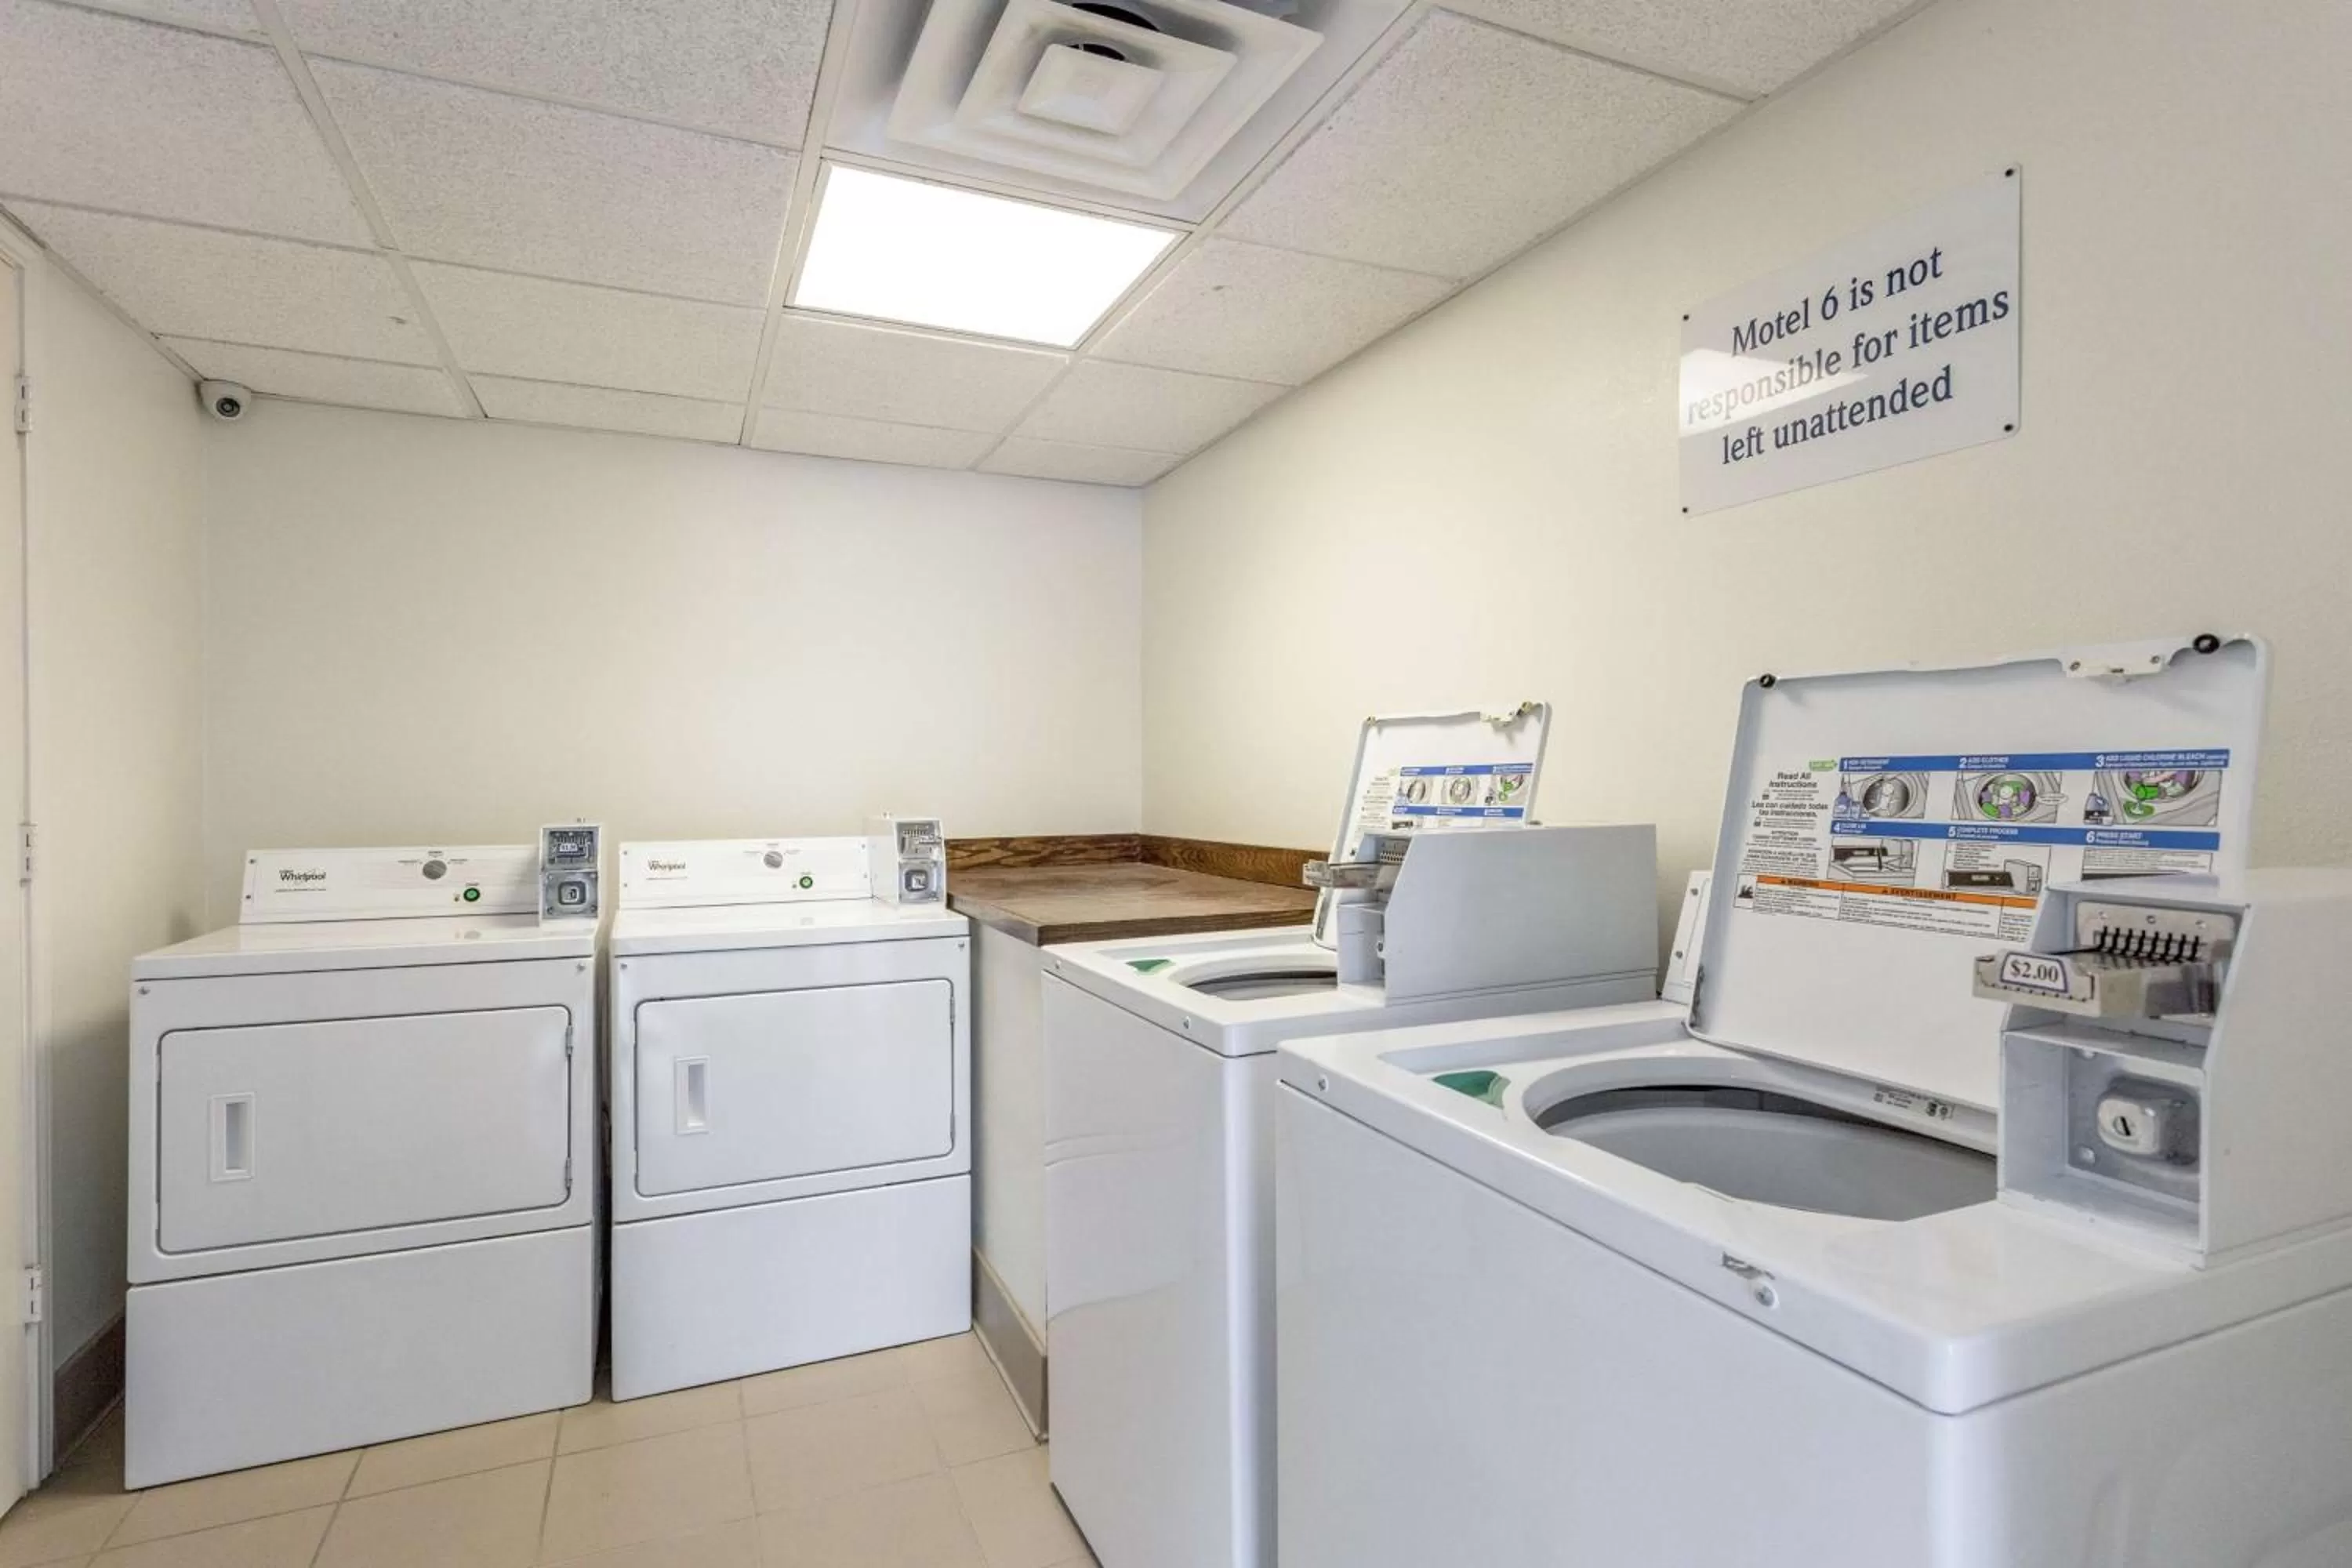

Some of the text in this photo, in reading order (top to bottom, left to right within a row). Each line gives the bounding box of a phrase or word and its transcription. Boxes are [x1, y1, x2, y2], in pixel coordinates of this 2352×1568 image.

[1730, 246, 1944, 358] Motel 6 is not
[1687, 290, 2010, 424] responsible for items
[1722, 365, 1954, 465] left unattended
[1959, 759, 1967, 768] 2
[2096, 755, 2105, 767] 3
[1833, 823, 1841, 832] 4
[1947, 826, 1957, 837] 5
[2085, 831, 2095, 843] 6
[648, 860, 686, 872] Whirlpool
[278, 869, 327, 882] Whirlpool
[2009, 961, 2059, 983] $2.00
